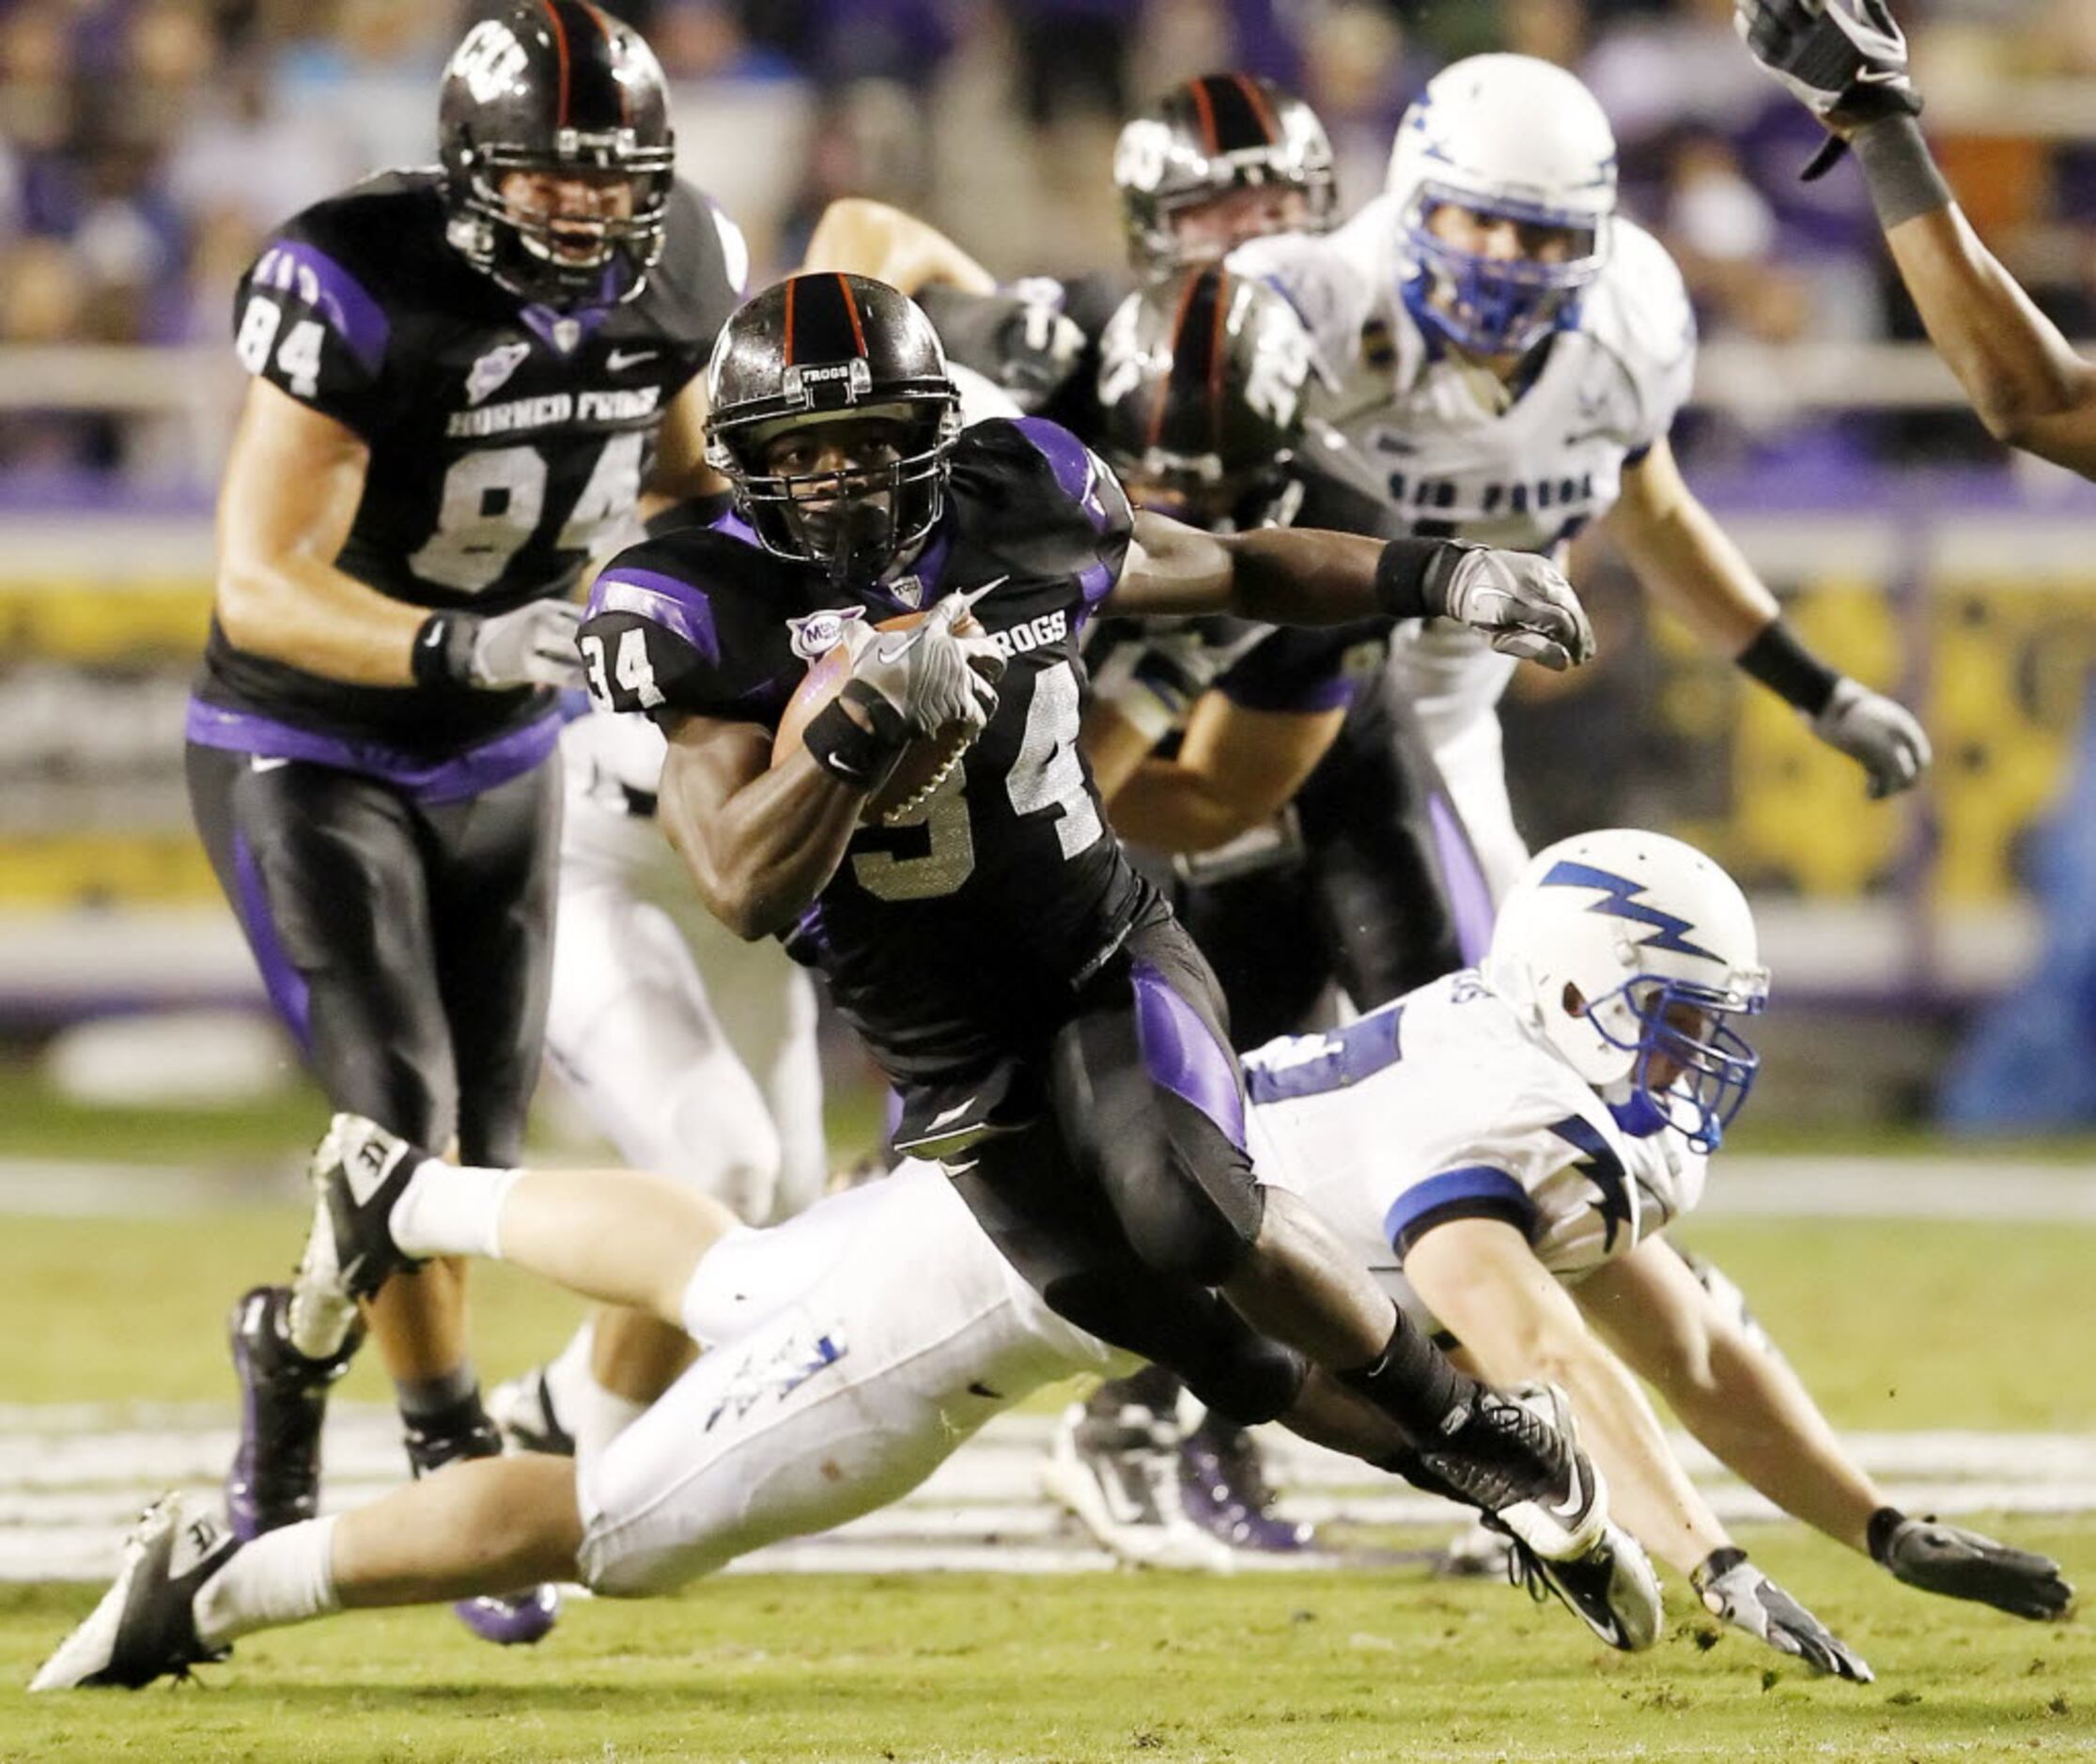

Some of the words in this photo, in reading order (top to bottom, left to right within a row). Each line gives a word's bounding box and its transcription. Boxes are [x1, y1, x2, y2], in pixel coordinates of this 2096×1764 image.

[236, 295, 326, 396] 84
[801, 365, 848, 383] FROGS
[408, 431, 653, 594] 84
[581, 627, 666, 714] 34
[989, 609, 1067, 658] ROGS
